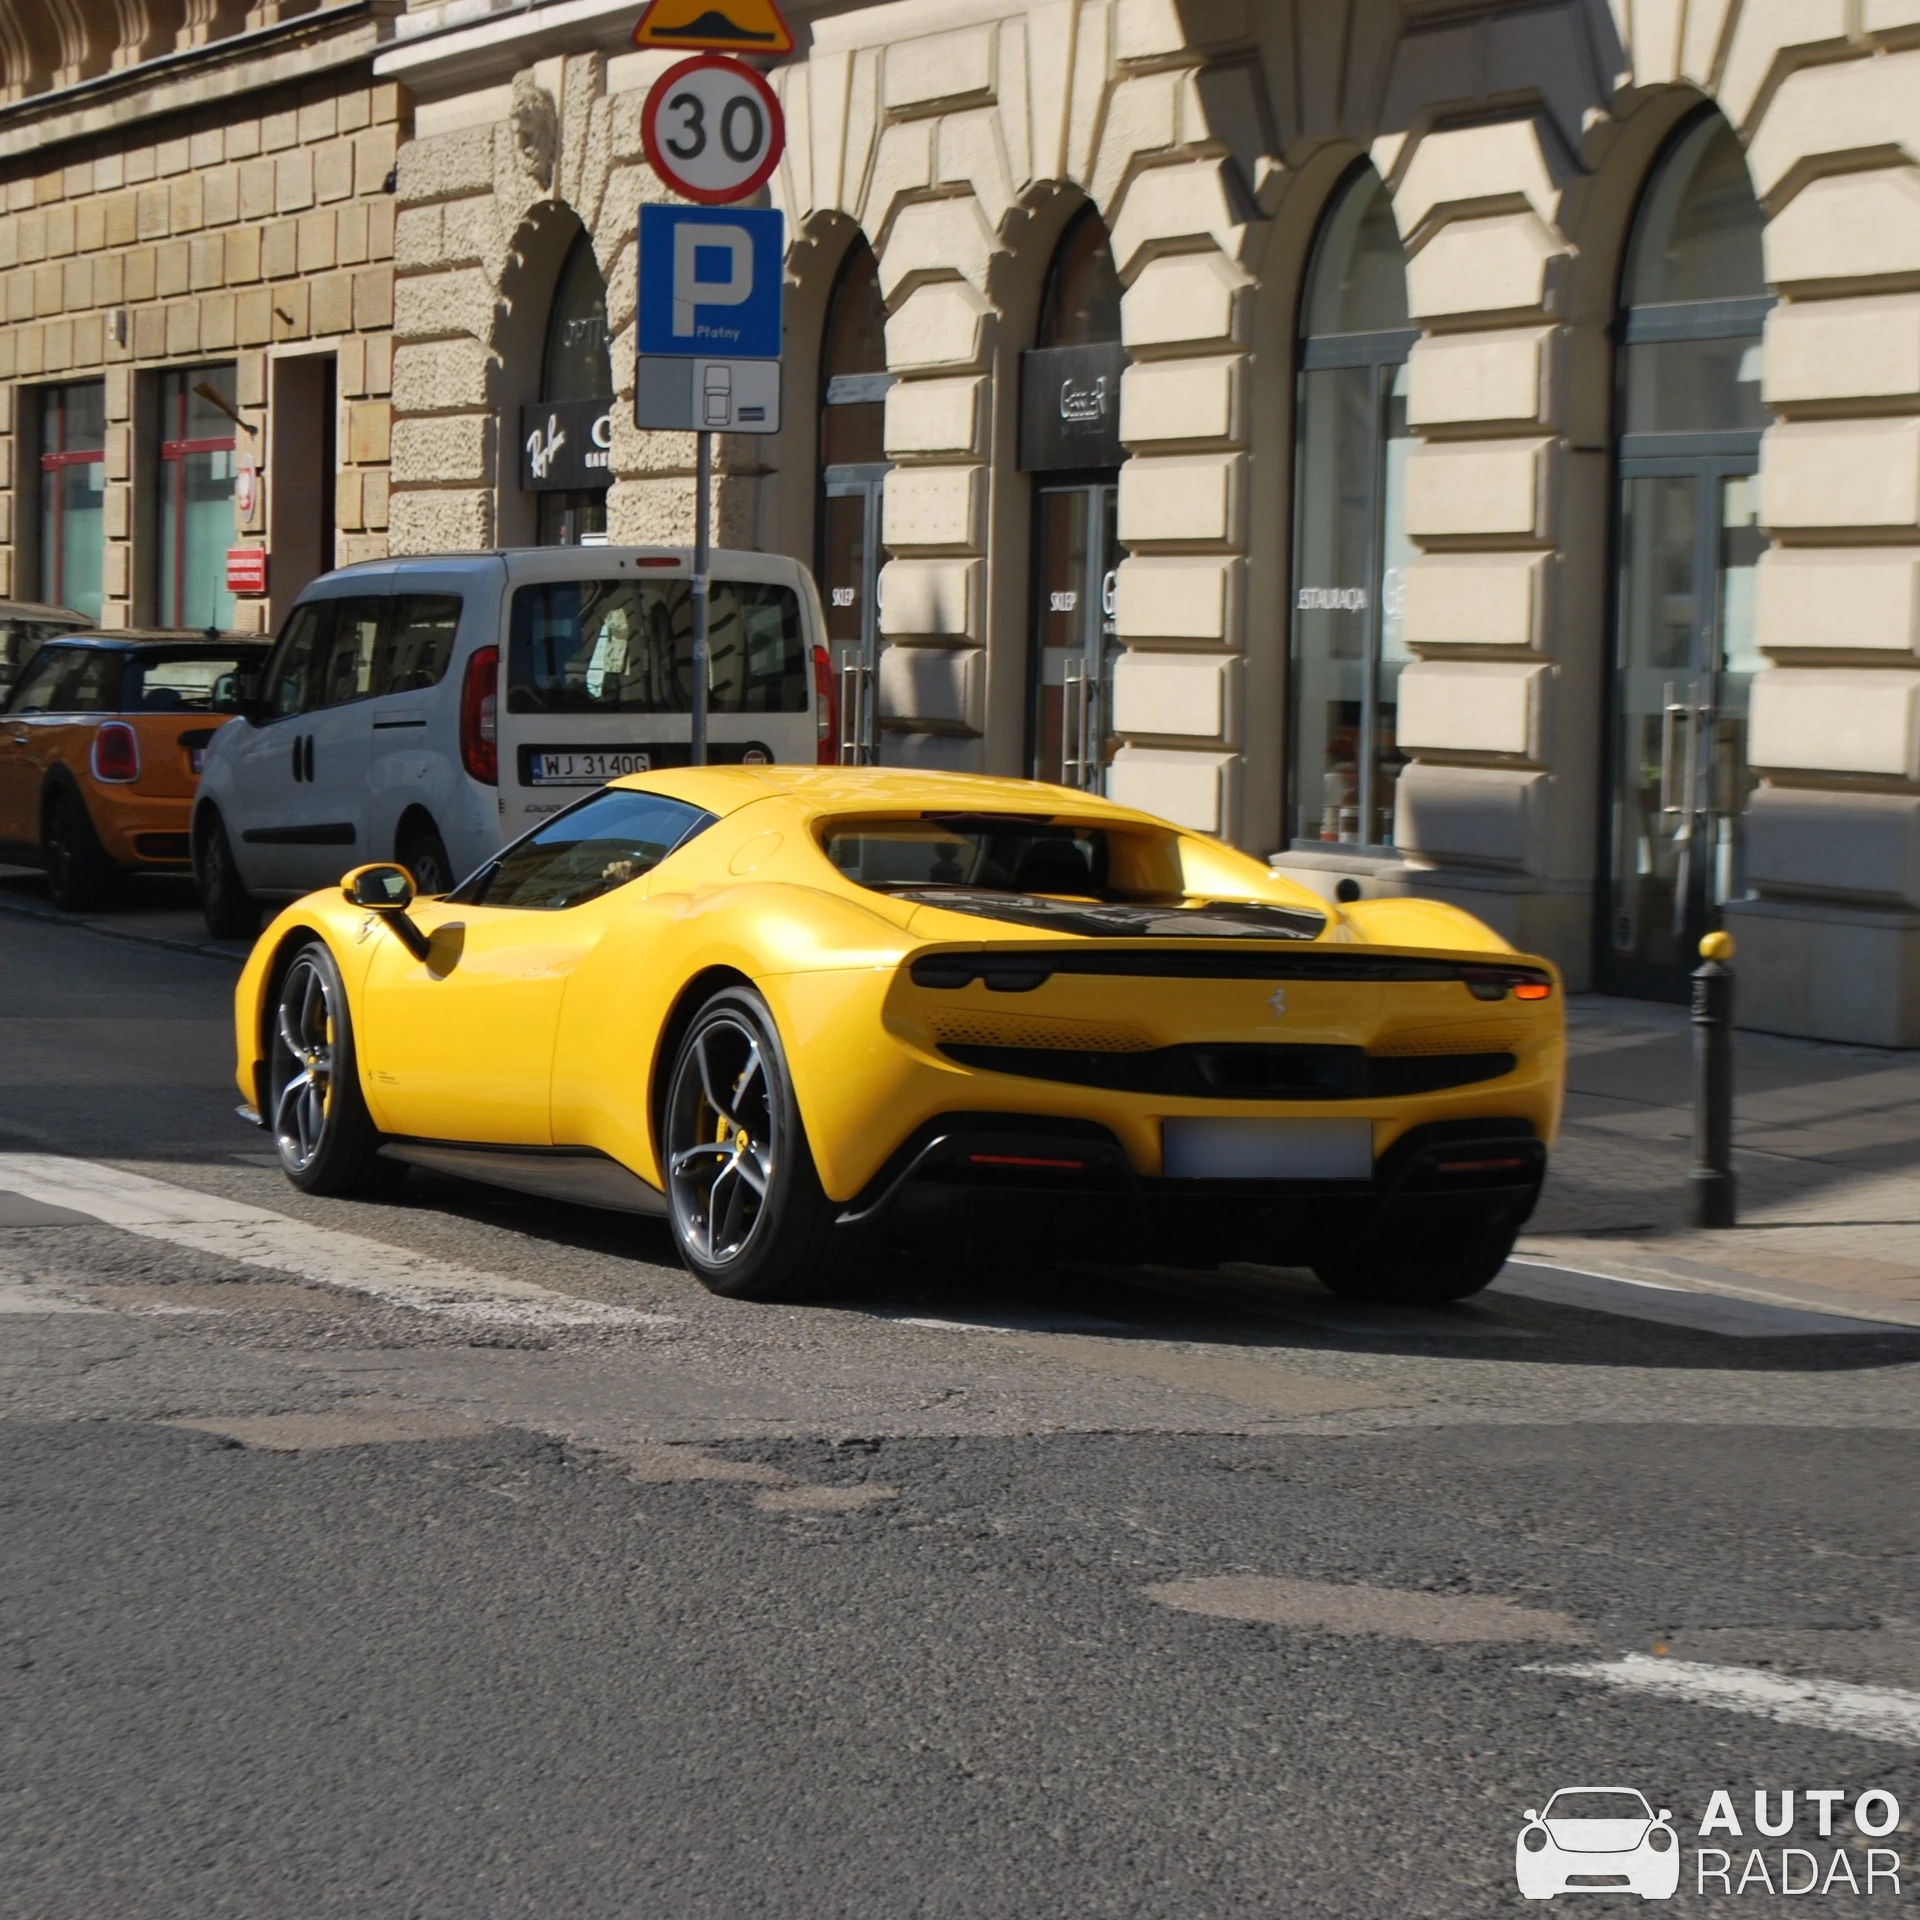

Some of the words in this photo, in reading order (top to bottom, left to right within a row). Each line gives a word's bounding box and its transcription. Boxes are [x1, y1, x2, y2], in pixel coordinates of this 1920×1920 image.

[666, 93, 763, 163] 30
[672, 223, 754, 337] P
[697, 325, 740, 341] Płatny
[583, 755, 647, 775] 3140G
